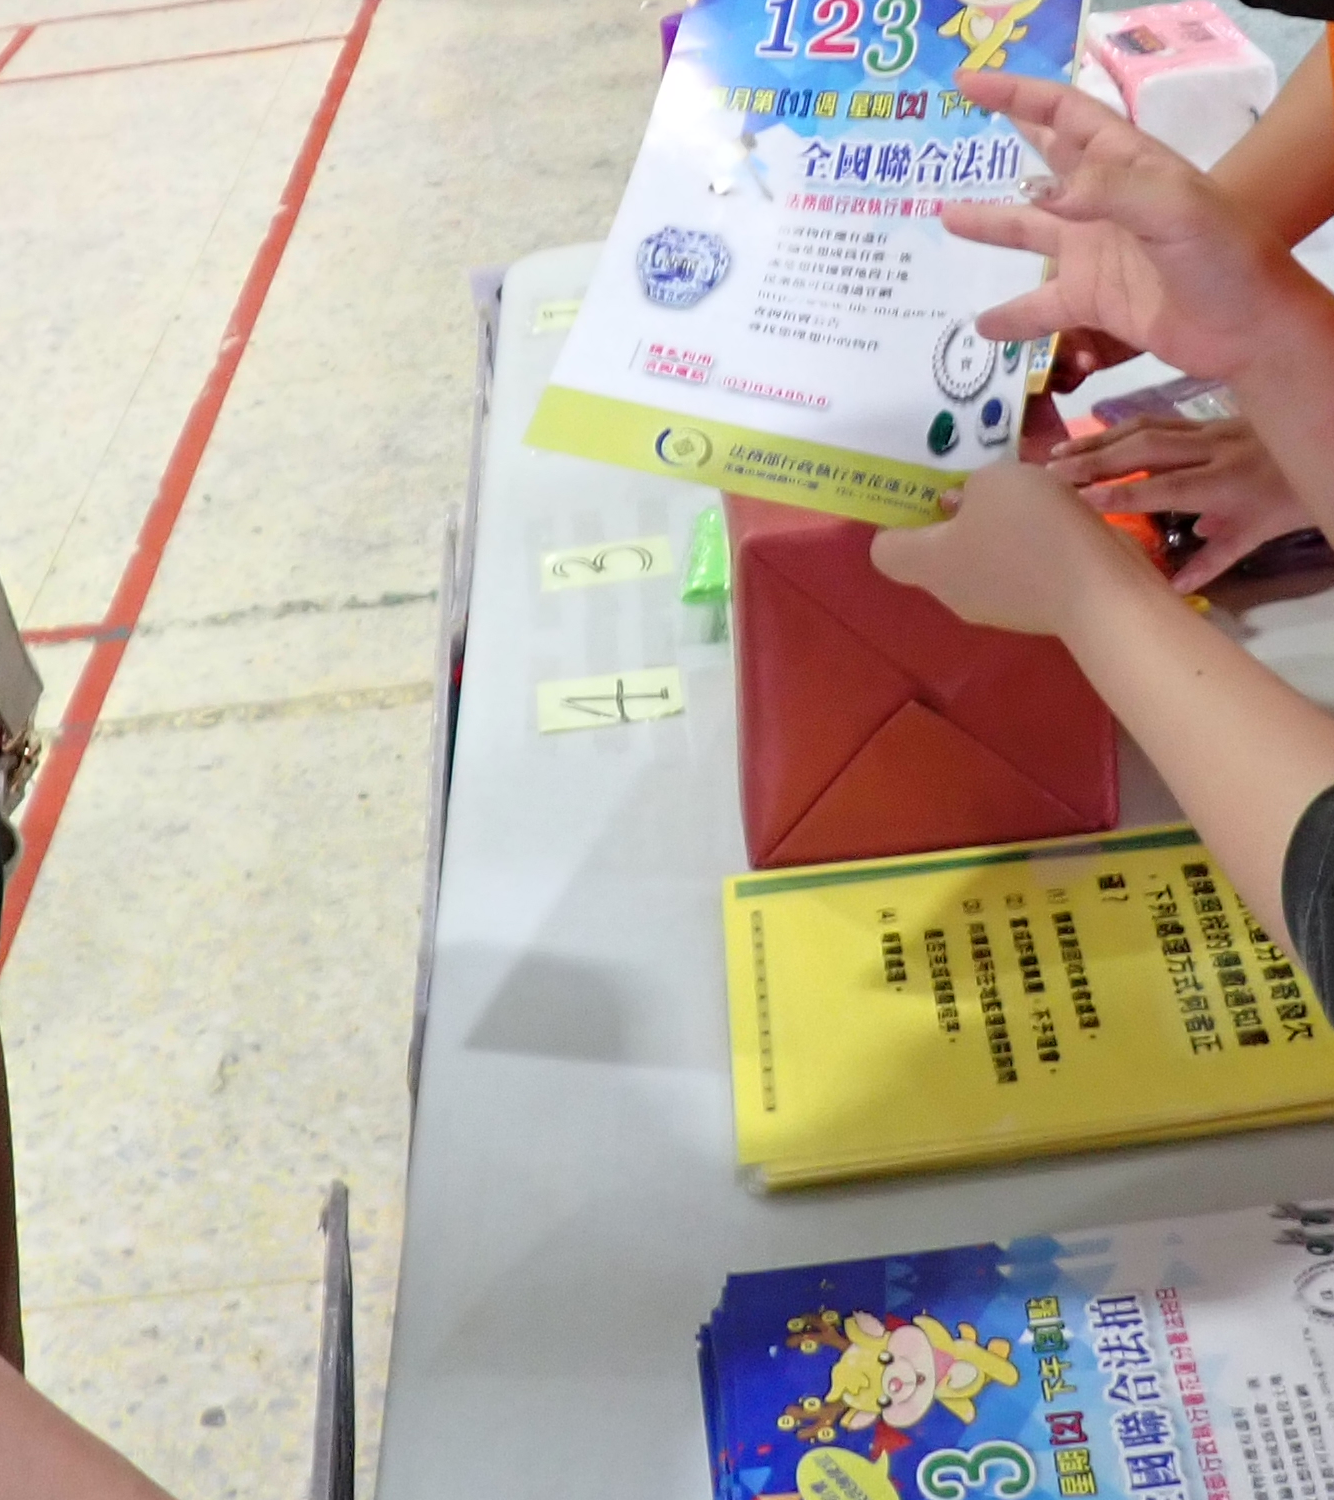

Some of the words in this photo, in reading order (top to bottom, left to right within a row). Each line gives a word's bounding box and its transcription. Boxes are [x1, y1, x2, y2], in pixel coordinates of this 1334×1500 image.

[802, 137, 1021, 183] 全國聯合法拍
[560, 678, 670, 723] 4
[1087, 1294, 1185, 1500] 國聯合法拍
